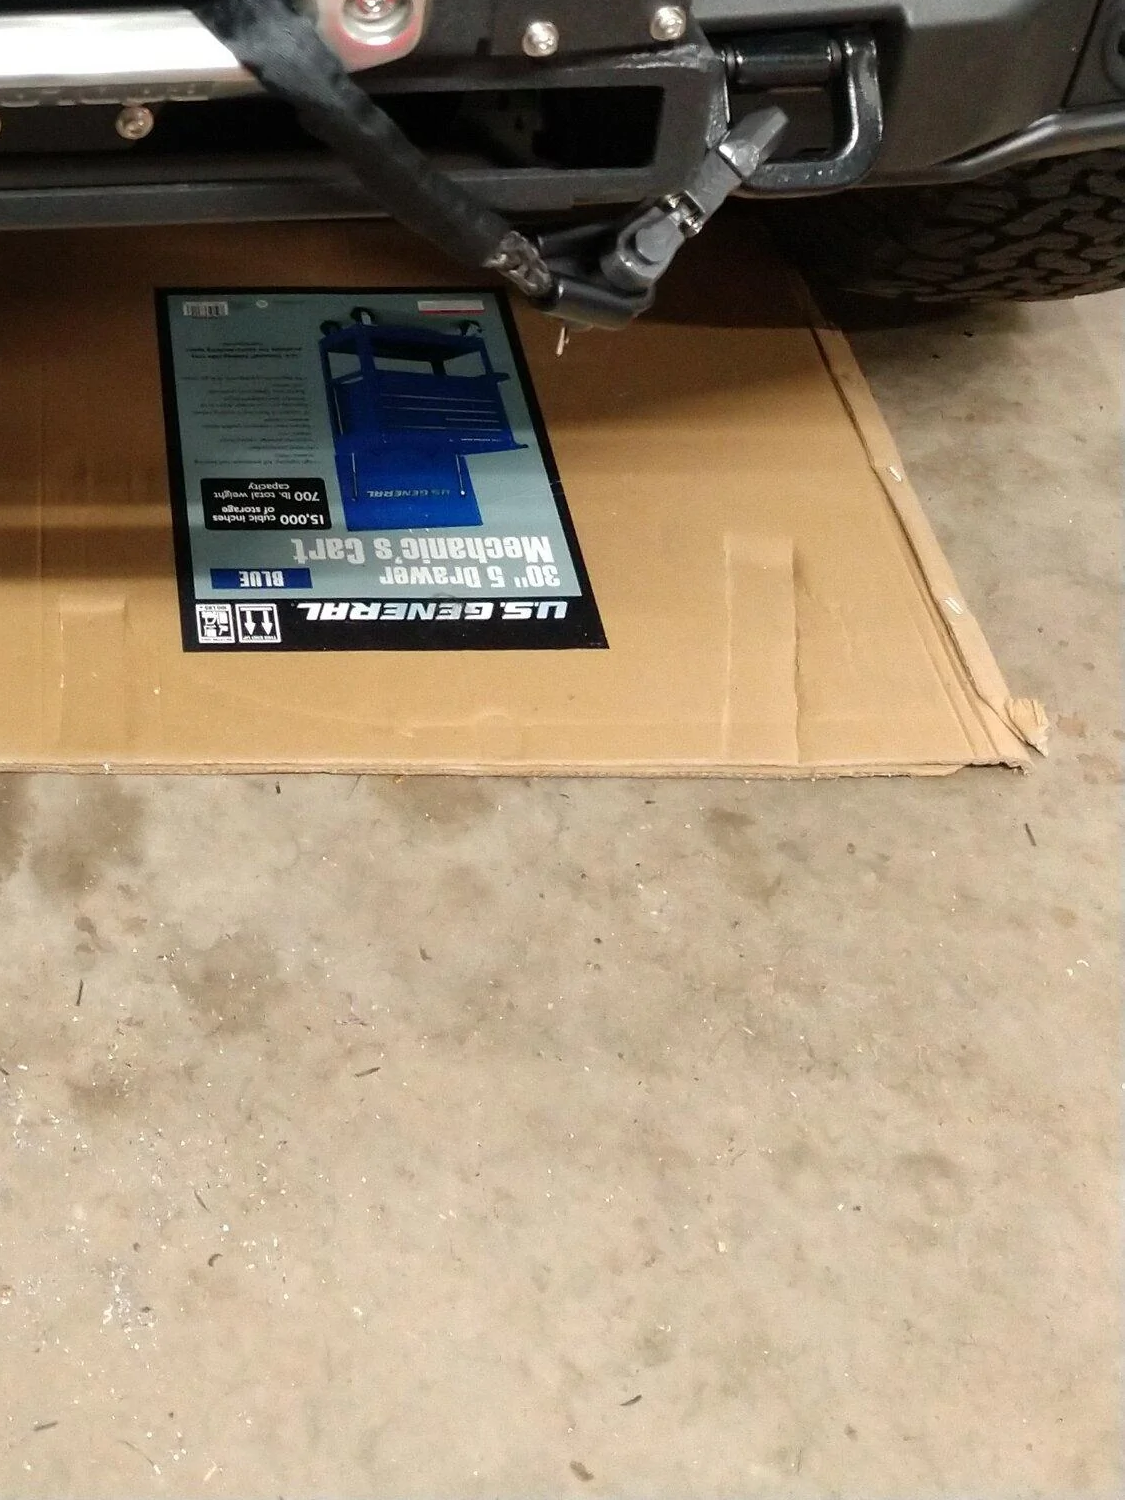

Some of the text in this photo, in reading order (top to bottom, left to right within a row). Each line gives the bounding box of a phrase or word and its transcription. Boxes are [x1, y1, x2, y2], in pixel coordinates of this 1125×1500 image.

[247, 482, 290, 490] capacity
[213, 490, 320, 501] 700 lb. total weight
[221, 504, 275, 514] of storage
[212, 513, 325, 525] 15,000 cubic inches
[291, 536, 555, 564] Mechanic's Cart
[238, 570, 285, 587] BLUE
[379, 565, 561, 589] 30" 5 Drawer
